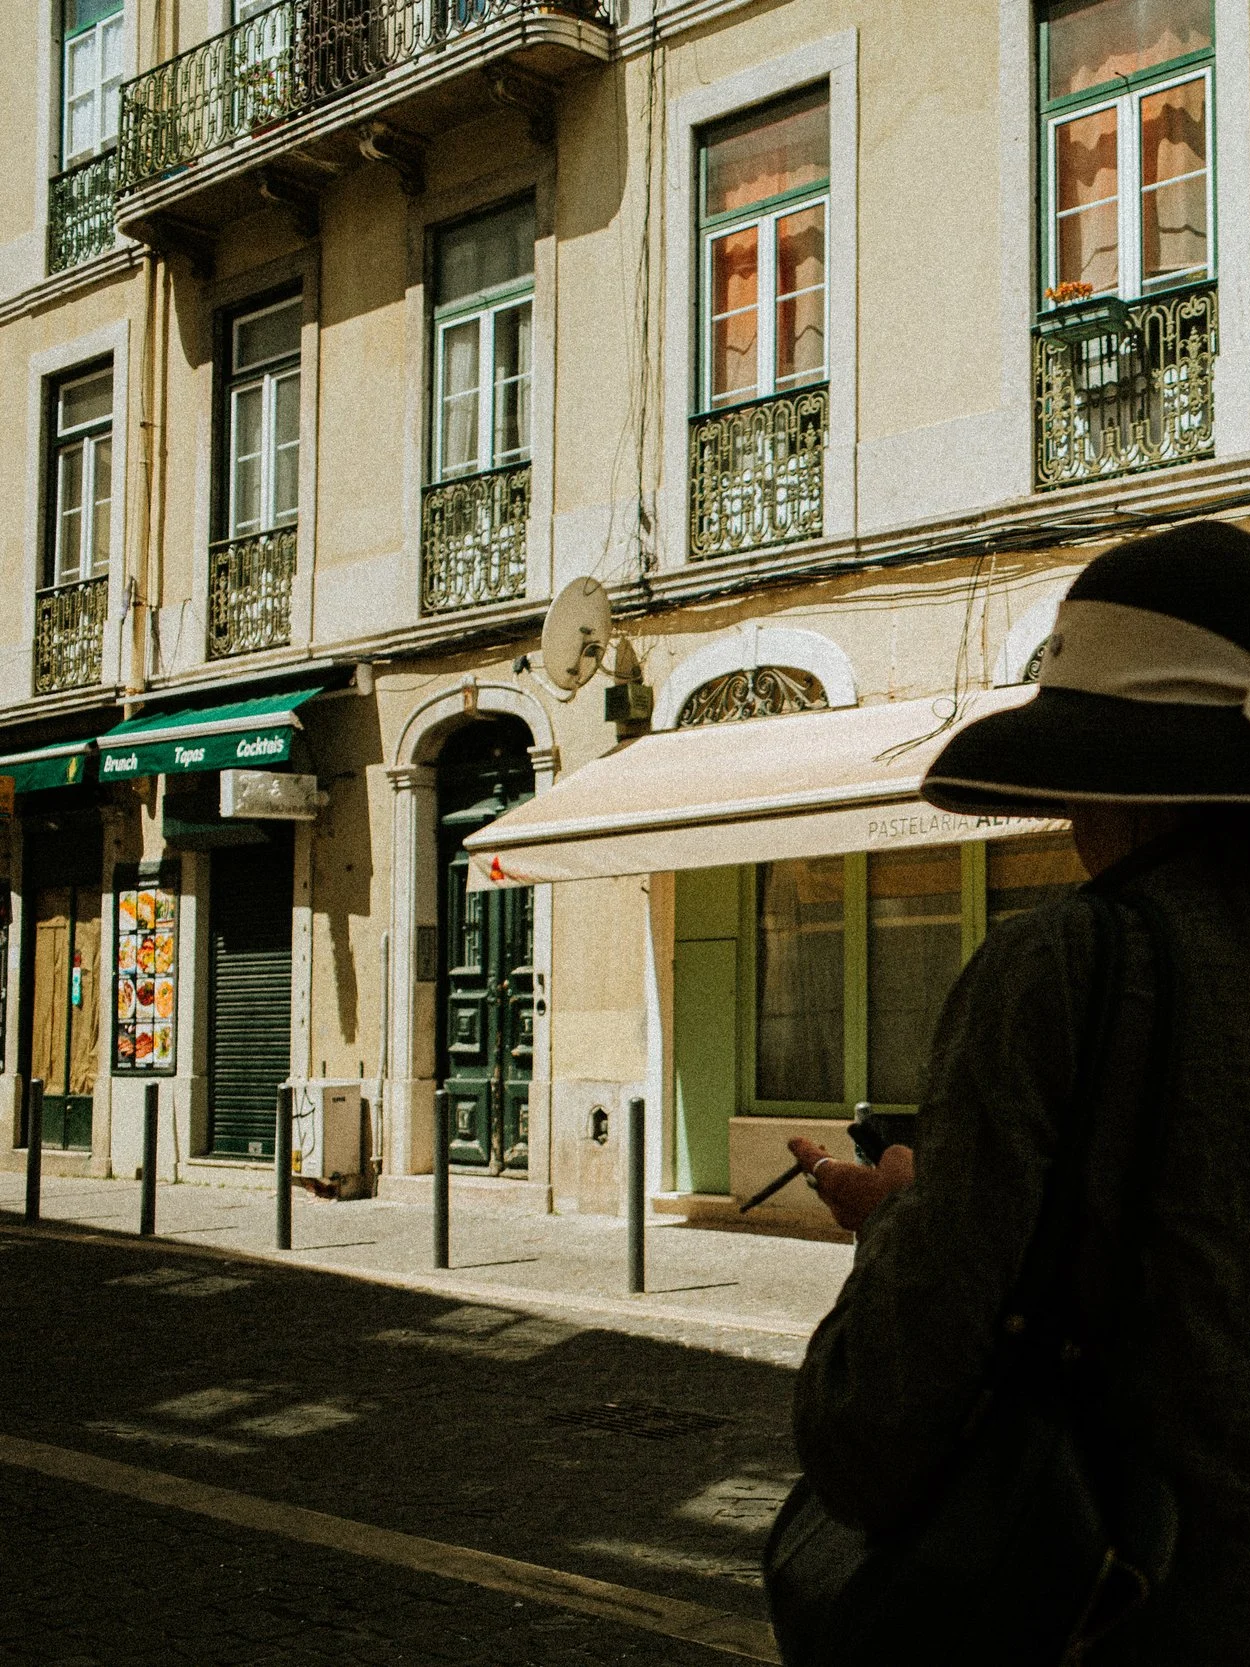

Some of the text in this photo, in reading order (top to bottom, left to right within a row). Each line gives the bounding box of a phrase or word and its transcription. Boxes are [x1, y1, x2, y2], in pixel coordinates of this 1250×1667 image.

[103, 752, 138, 773] Brunch
[174, 746, 206, 768] Tapas
[868, 814, 969, 838] PASTELARIA
